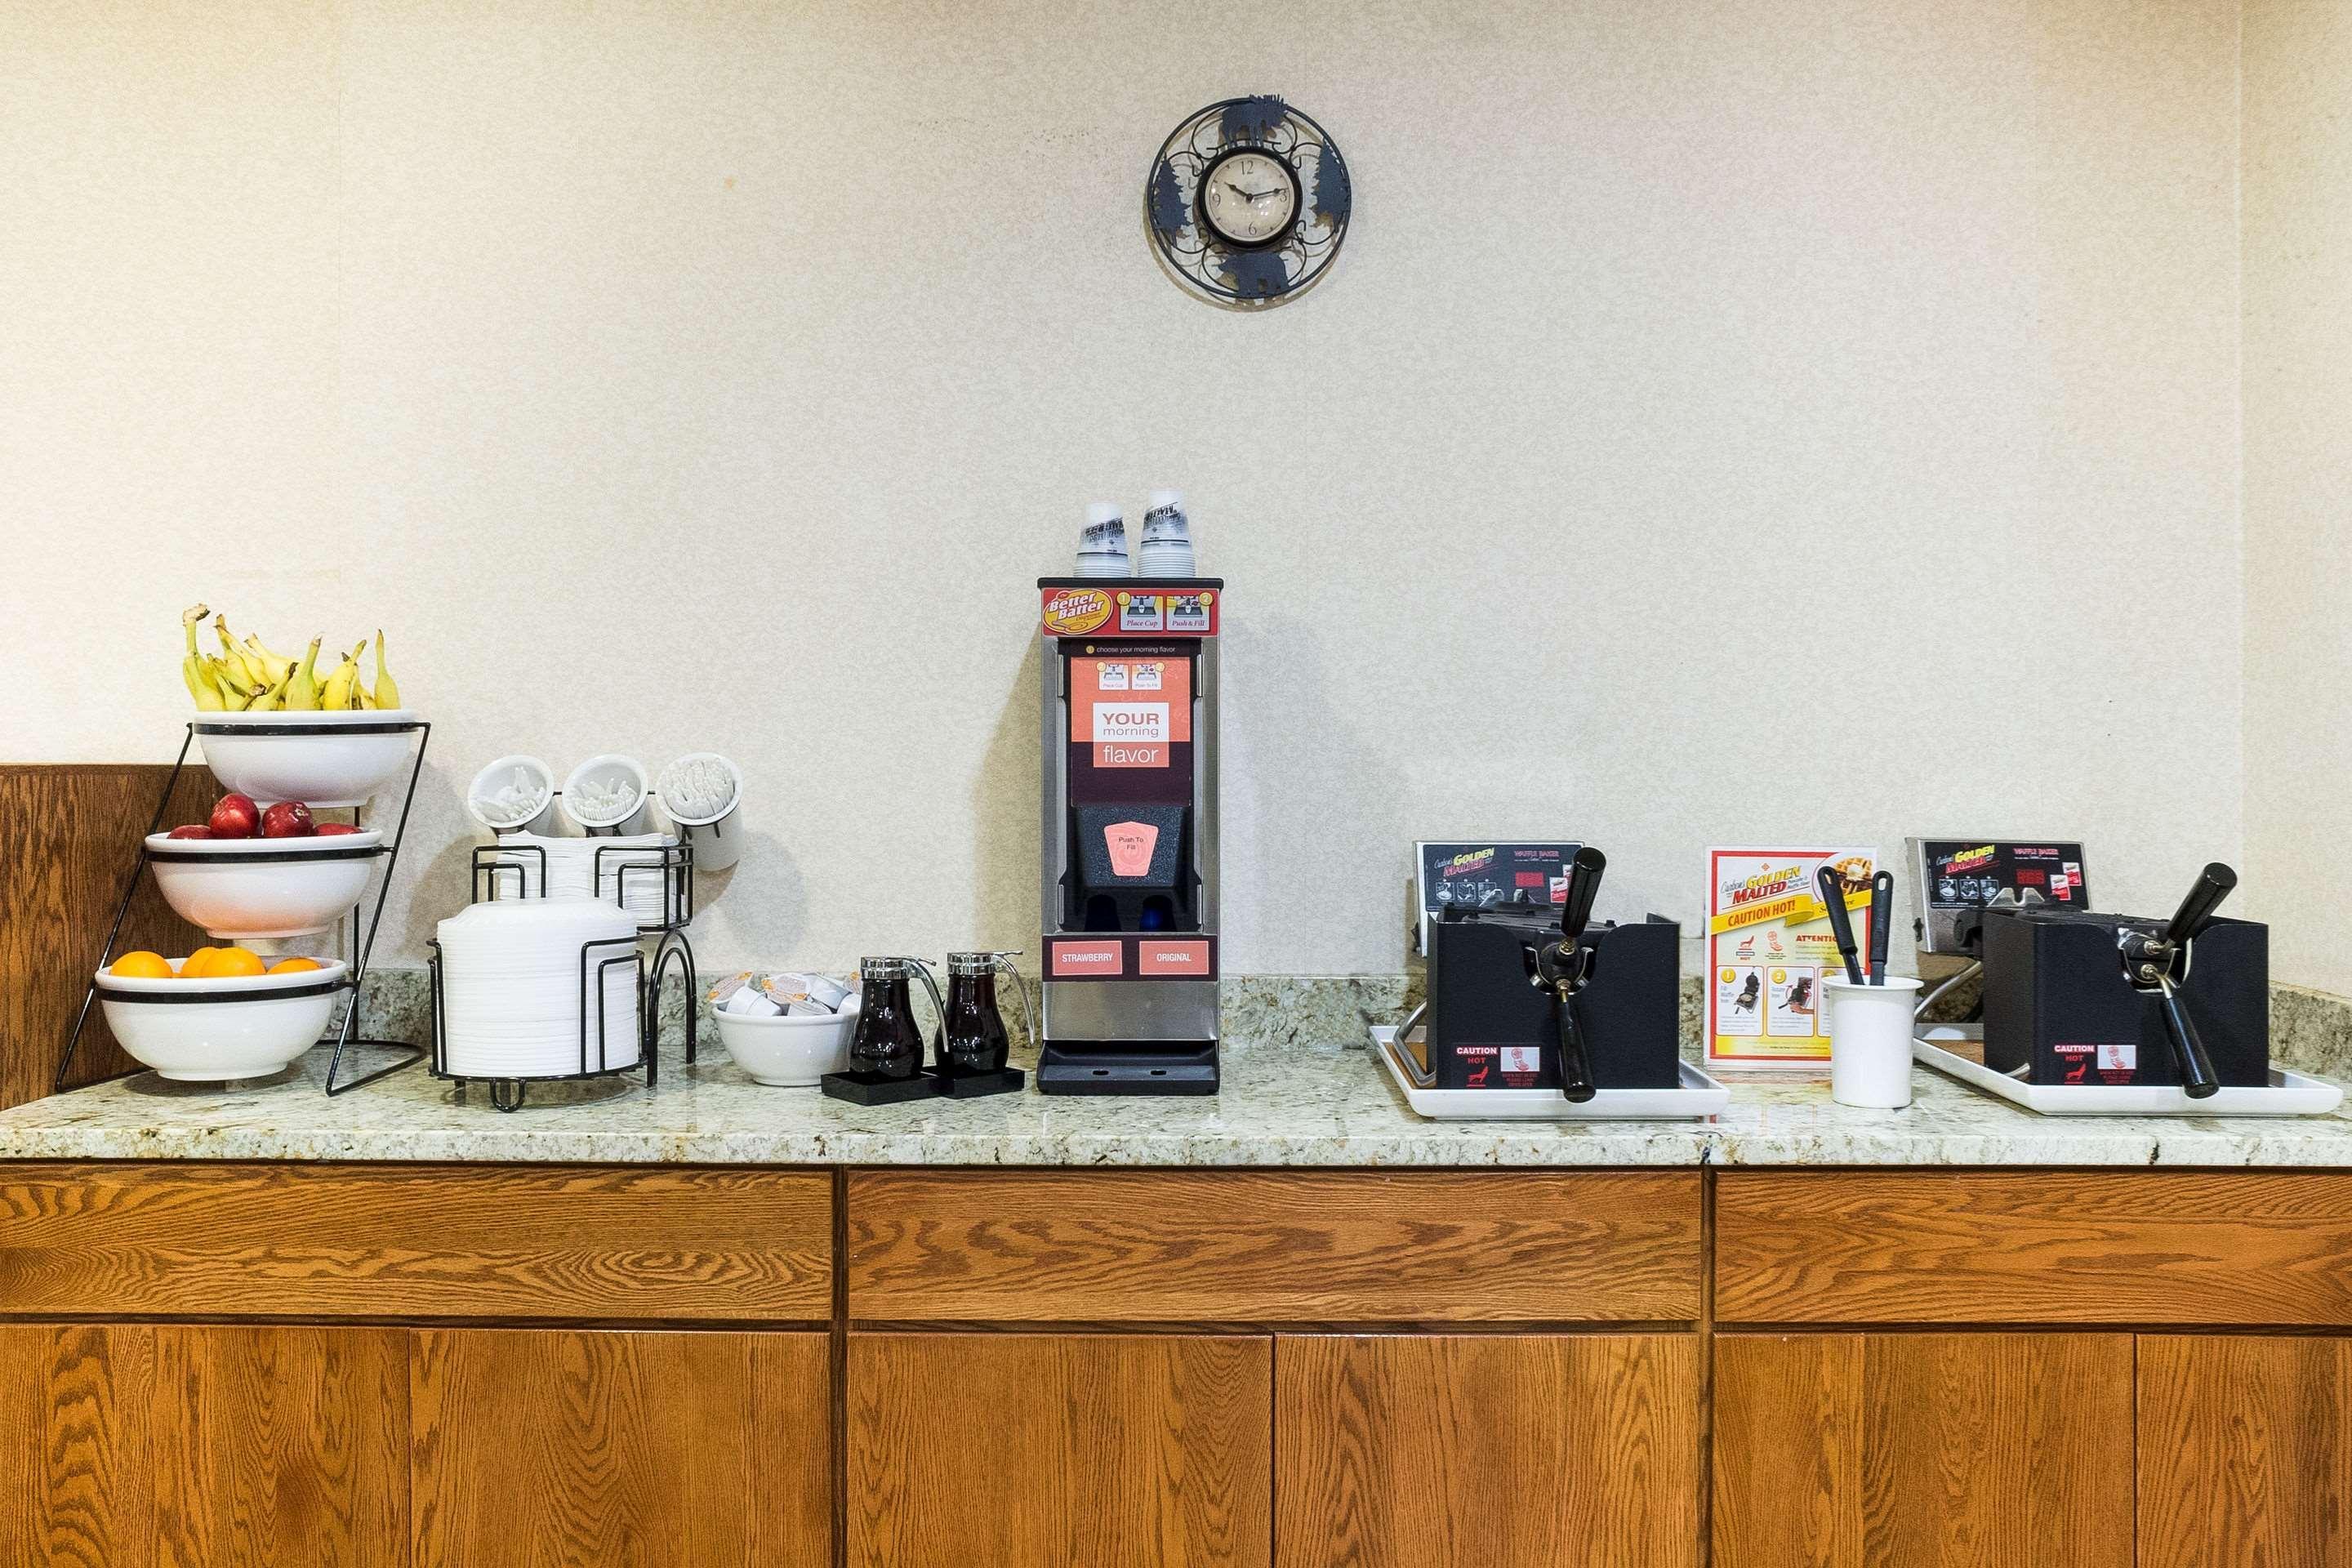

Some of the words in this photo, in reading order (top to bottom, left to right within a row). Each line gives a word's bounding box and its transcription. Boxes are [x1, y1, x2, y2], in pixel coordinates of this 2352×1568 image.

[1241, 160, 1254, 175] 12
[1213, 194, 1221, 207] 9
[1280, 189, 1287, 203] 3
[1249, 222, 1257, 235] 6
[1049, 592, 1097, 612] Better
[1058, 600, 1104, 621] Batter
[1102, 713, 1160, 724] YOUR
[1103, 726, 1159, 737] morning
[1103, 745, 1159, 763] flavor
[1454, 848, 1494, 866] GOLDEN
[1955, 844, 1995, 863] GOLDEN
[1746, 866, 1801, 889] GOLDEN
[1732, 881, 1787, 904] MALTED
[1728, 906, 1771, 927] CAUTION
[1773, 900, 1795, 915] HOT!
[1062, 953, 1113, 962] STRAWBERRY
[1156, 953, 1191, 961] ORIGINAL
